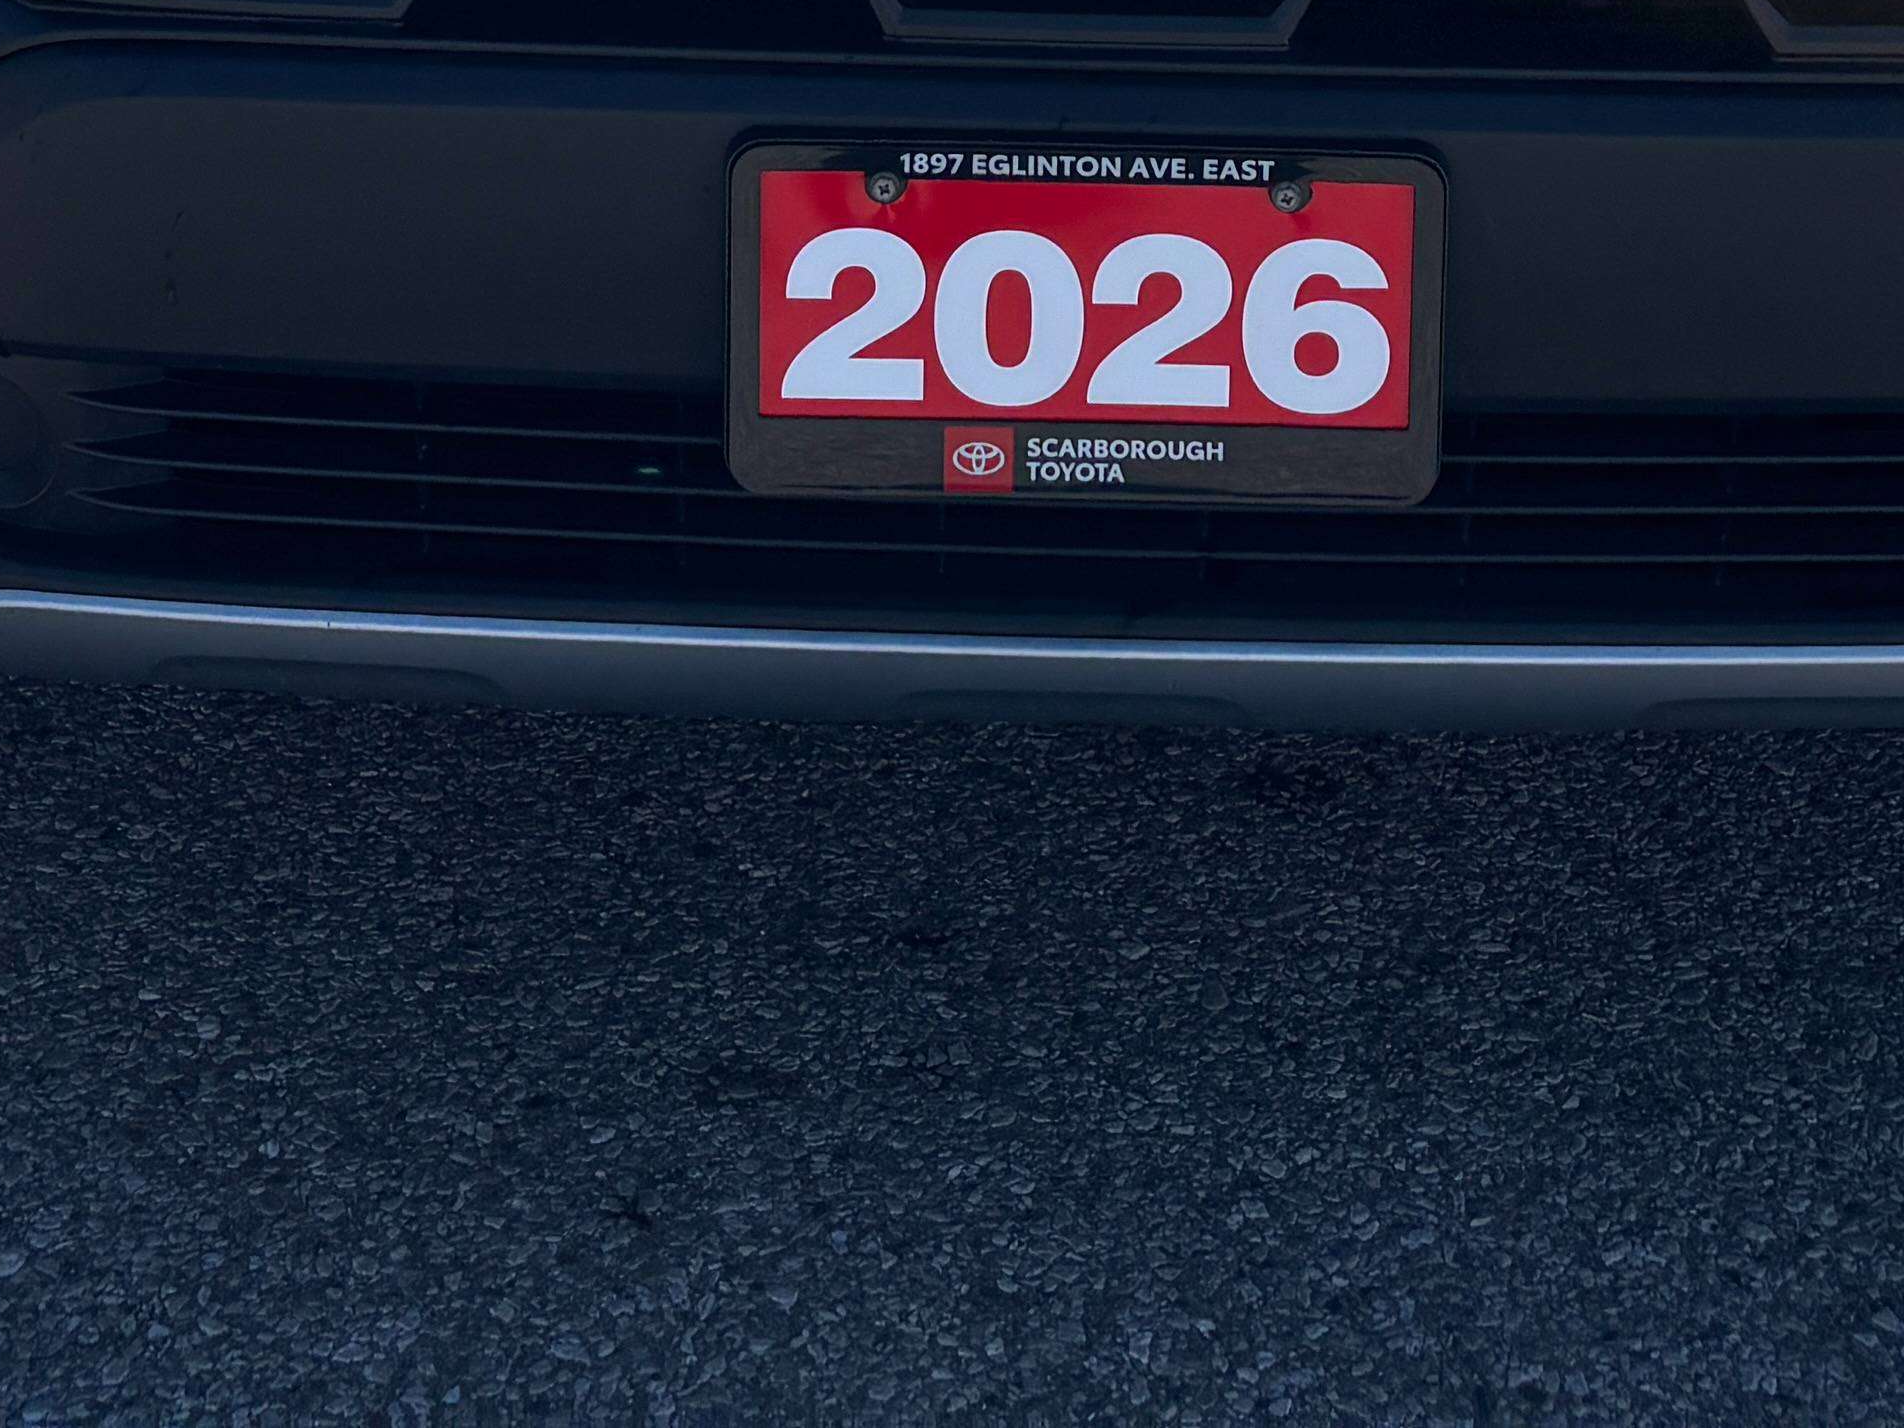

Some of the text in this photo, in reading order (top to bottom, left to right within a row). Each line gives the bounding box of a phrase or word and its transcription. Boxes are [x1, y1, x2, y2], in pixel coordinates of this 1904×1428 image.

[900, 153, 1275, 182] 1897 EGLINTON AVE. EAST
[781, 227, 1391, 415] 2026
[1026, 437, 1224, 462] SCARBOROUGH
[1026, 461, 1125, 483] TOYOTA
